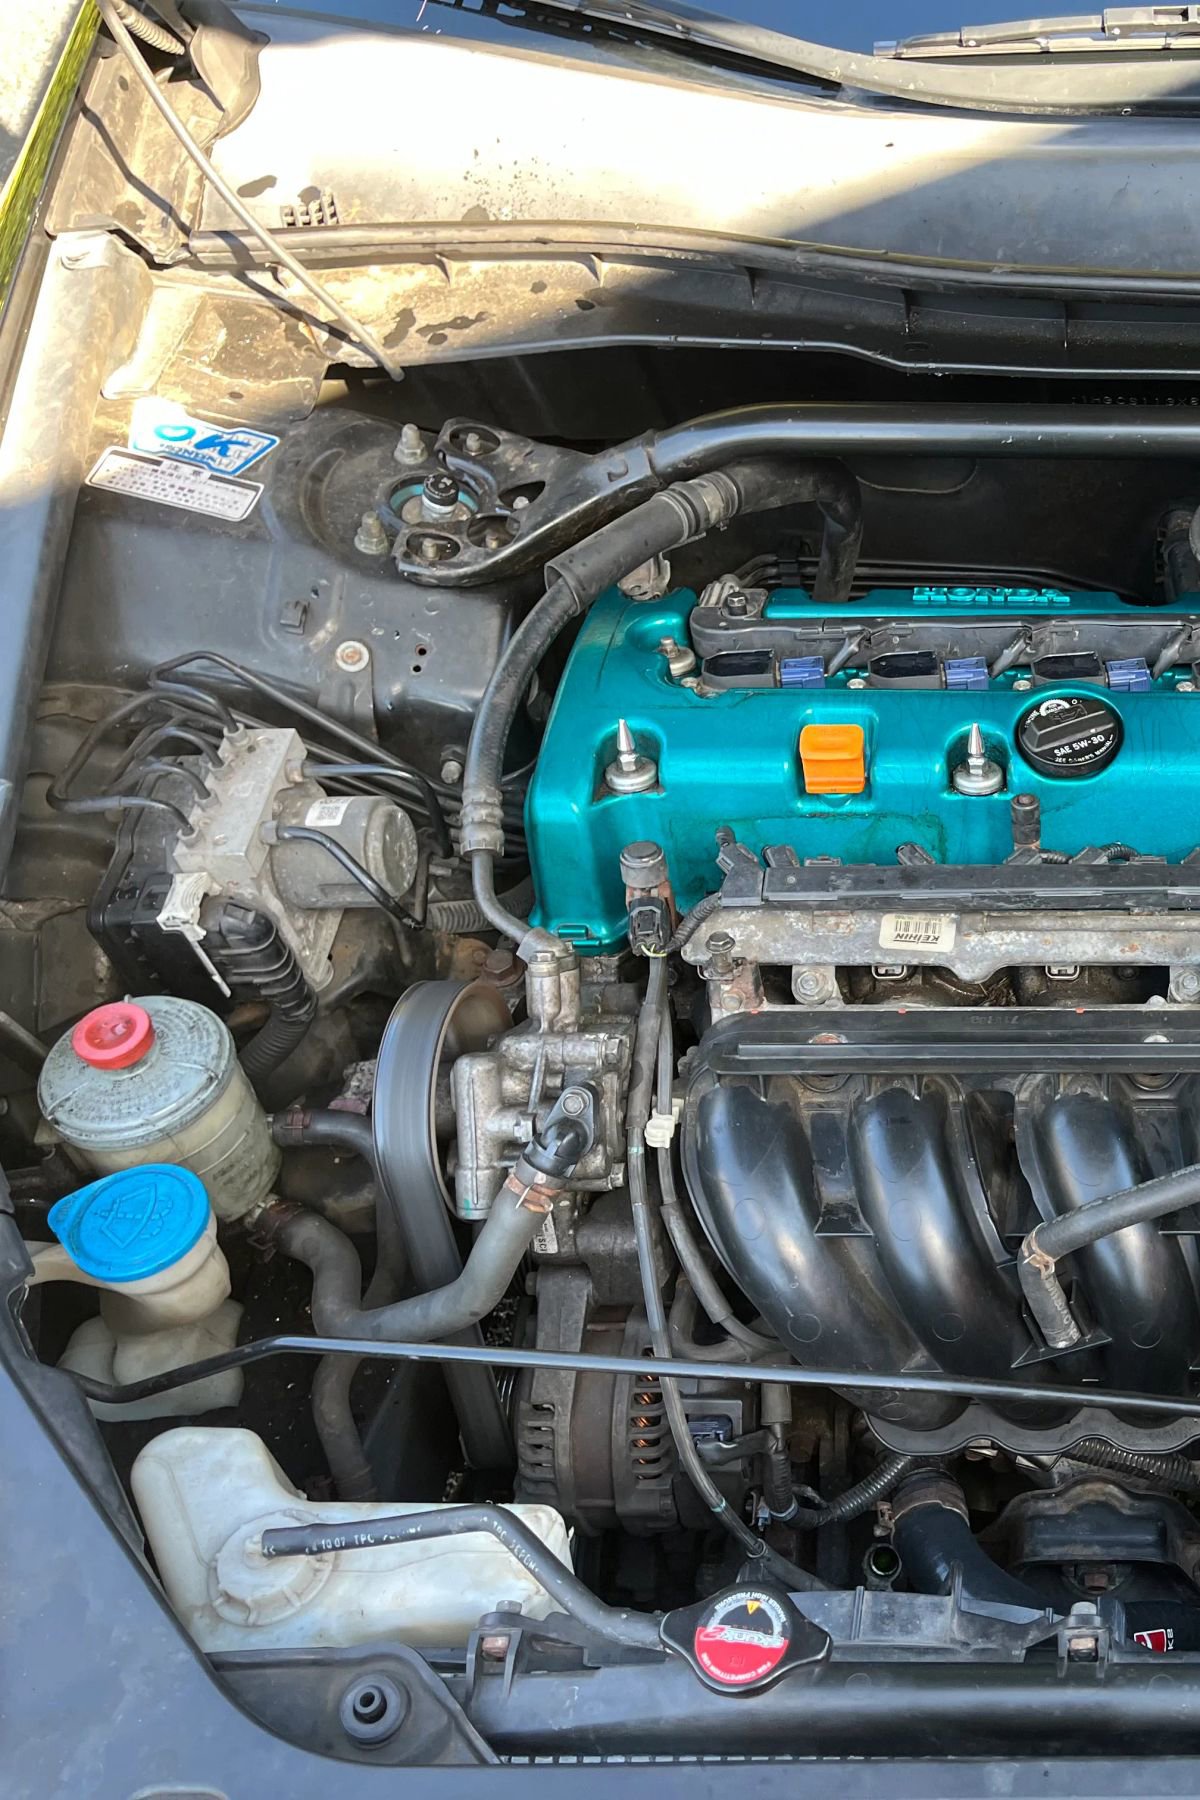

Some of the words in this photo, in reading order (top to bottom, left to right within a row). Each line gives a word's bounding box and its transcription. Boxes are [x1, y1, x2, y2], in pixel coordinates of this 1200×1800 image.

[912, 586, 1071, 603] HONDA
[1054, 745, 1072, 757] SAE
[1072, 734, 1105, 751] 5W-30
[895, 932, 940, 944] KEIHIN
